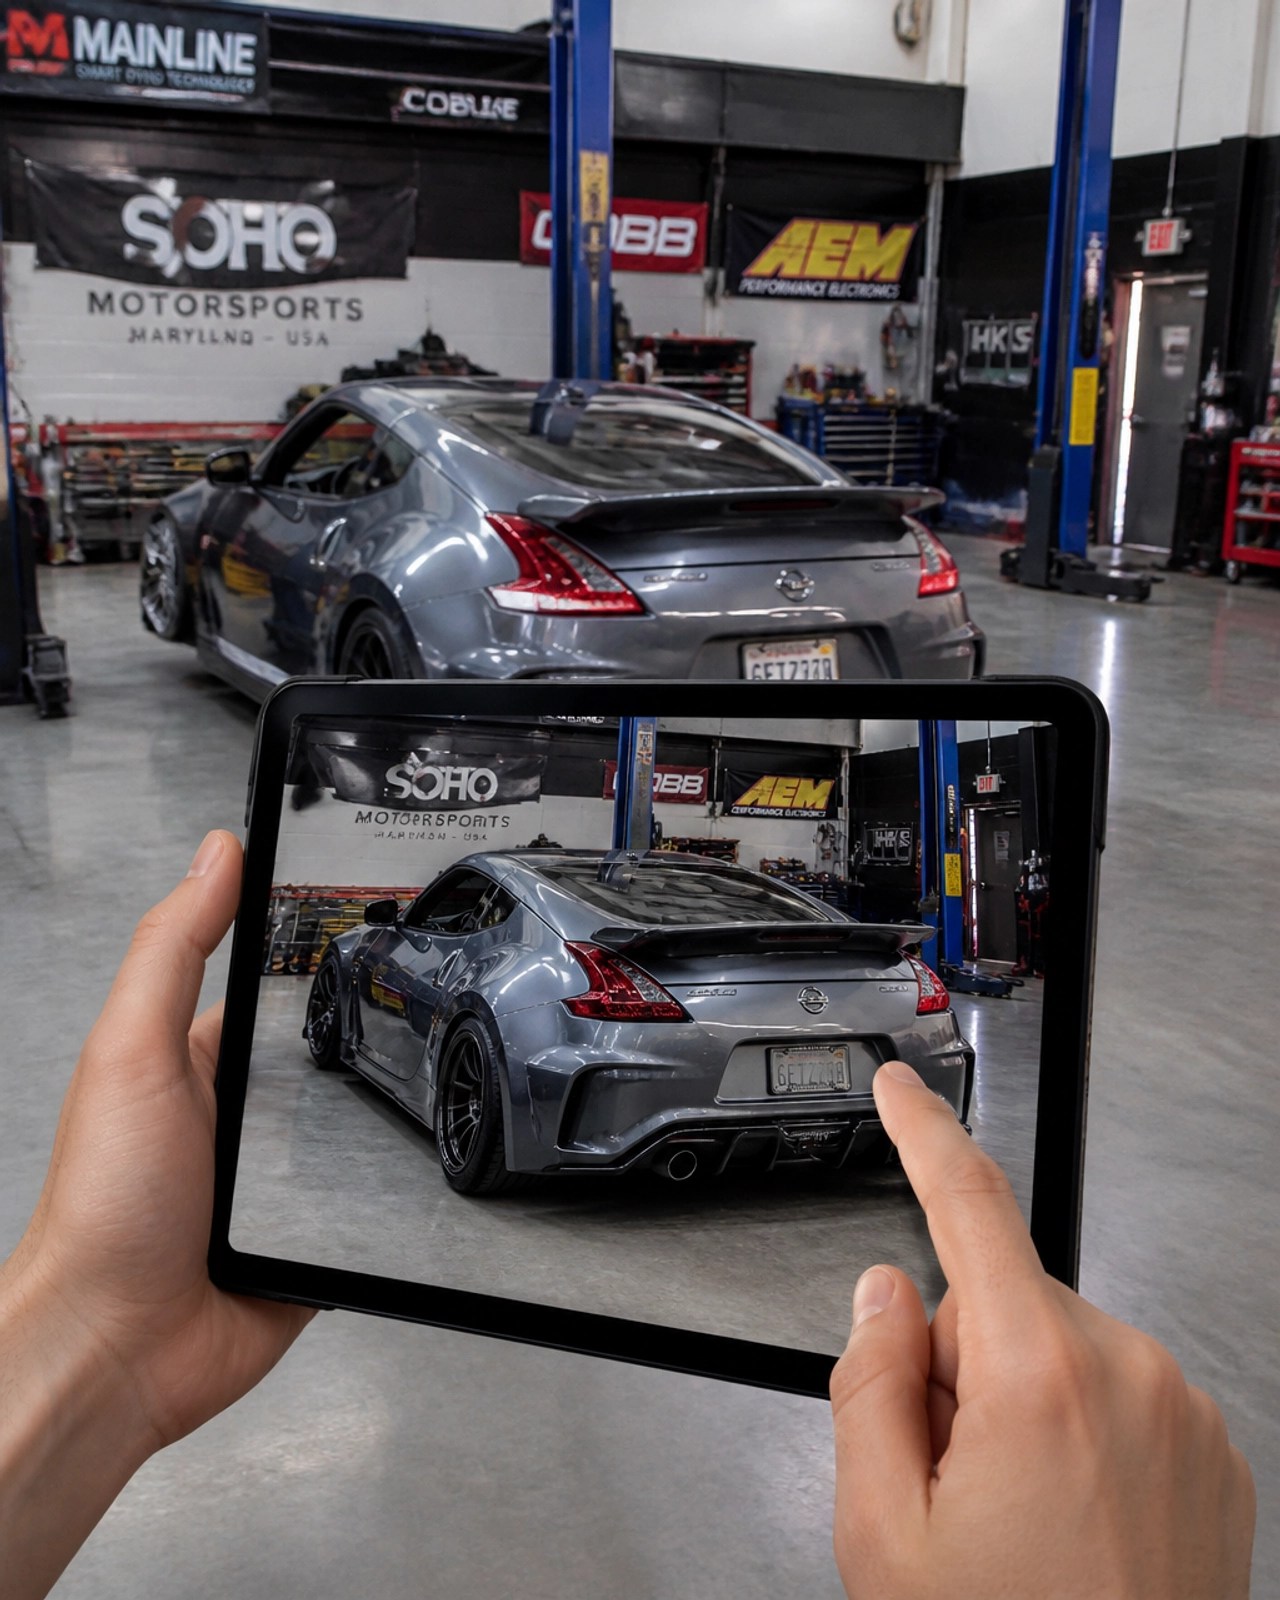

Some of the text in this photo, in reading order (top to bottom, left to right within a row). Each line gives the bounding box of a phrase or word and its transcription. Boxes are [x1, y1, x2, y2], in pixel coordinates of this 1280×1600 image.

[73, 15, 257, 76] MAINLINE
[121, 194, 337, 274] SOHO
[531, 209, 698, 258] CBB
[743, 217, 918, 282] AEM
[87, 291, 365, 323] MOTORSPORTS
[285, 330, 330, 348] USA
[971, 325, 1033, 353] HKS
[733, 774, 835, 810] AEM
